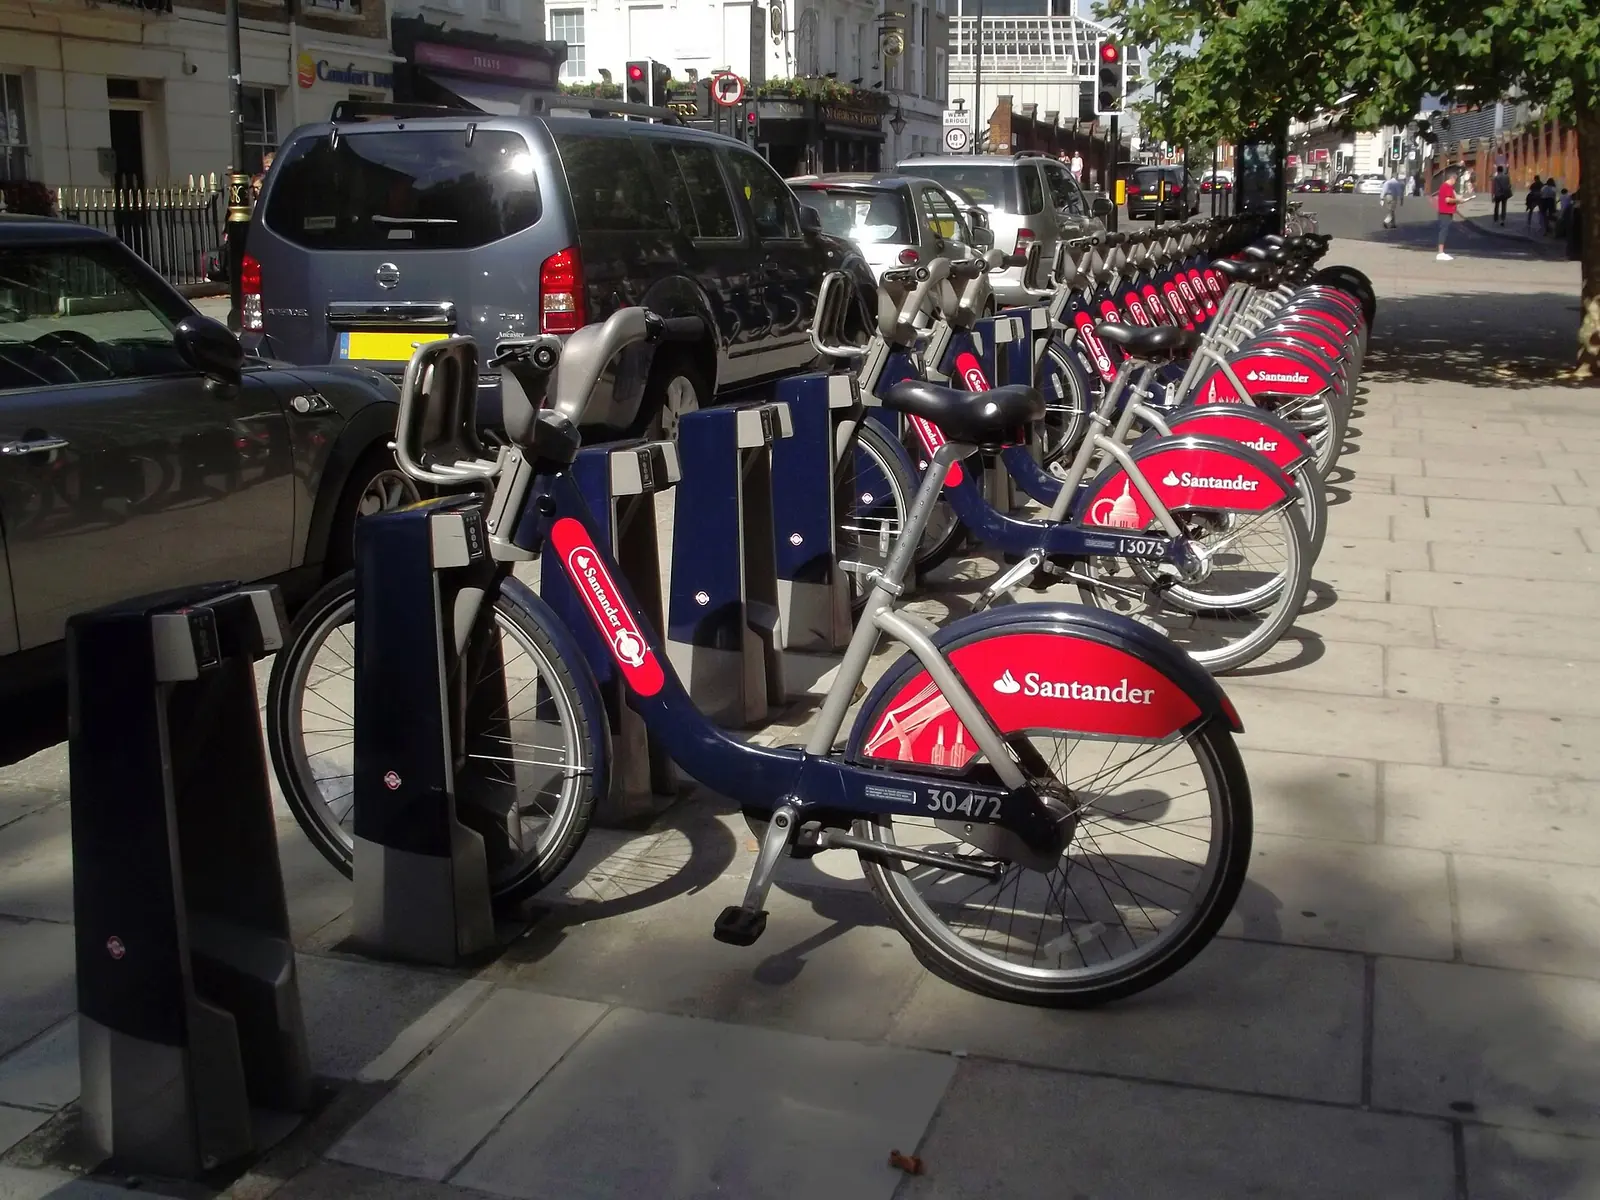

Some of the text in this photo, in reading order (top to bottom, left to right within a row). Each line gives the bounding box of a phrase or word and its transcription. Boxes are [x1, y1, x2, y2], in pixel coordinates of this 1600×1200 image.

[473, 56, 500, 70] TREATS
[1258, 370, 1310, 383] Santander
[1180, 472, 1259, 492] Santander
[1119, 539, 1165, 557] 13075
[583, 567, 622, 628] Santander
[1024, 672, 1156, 706] Santander
[926, 788, 1003, 820] 30472
